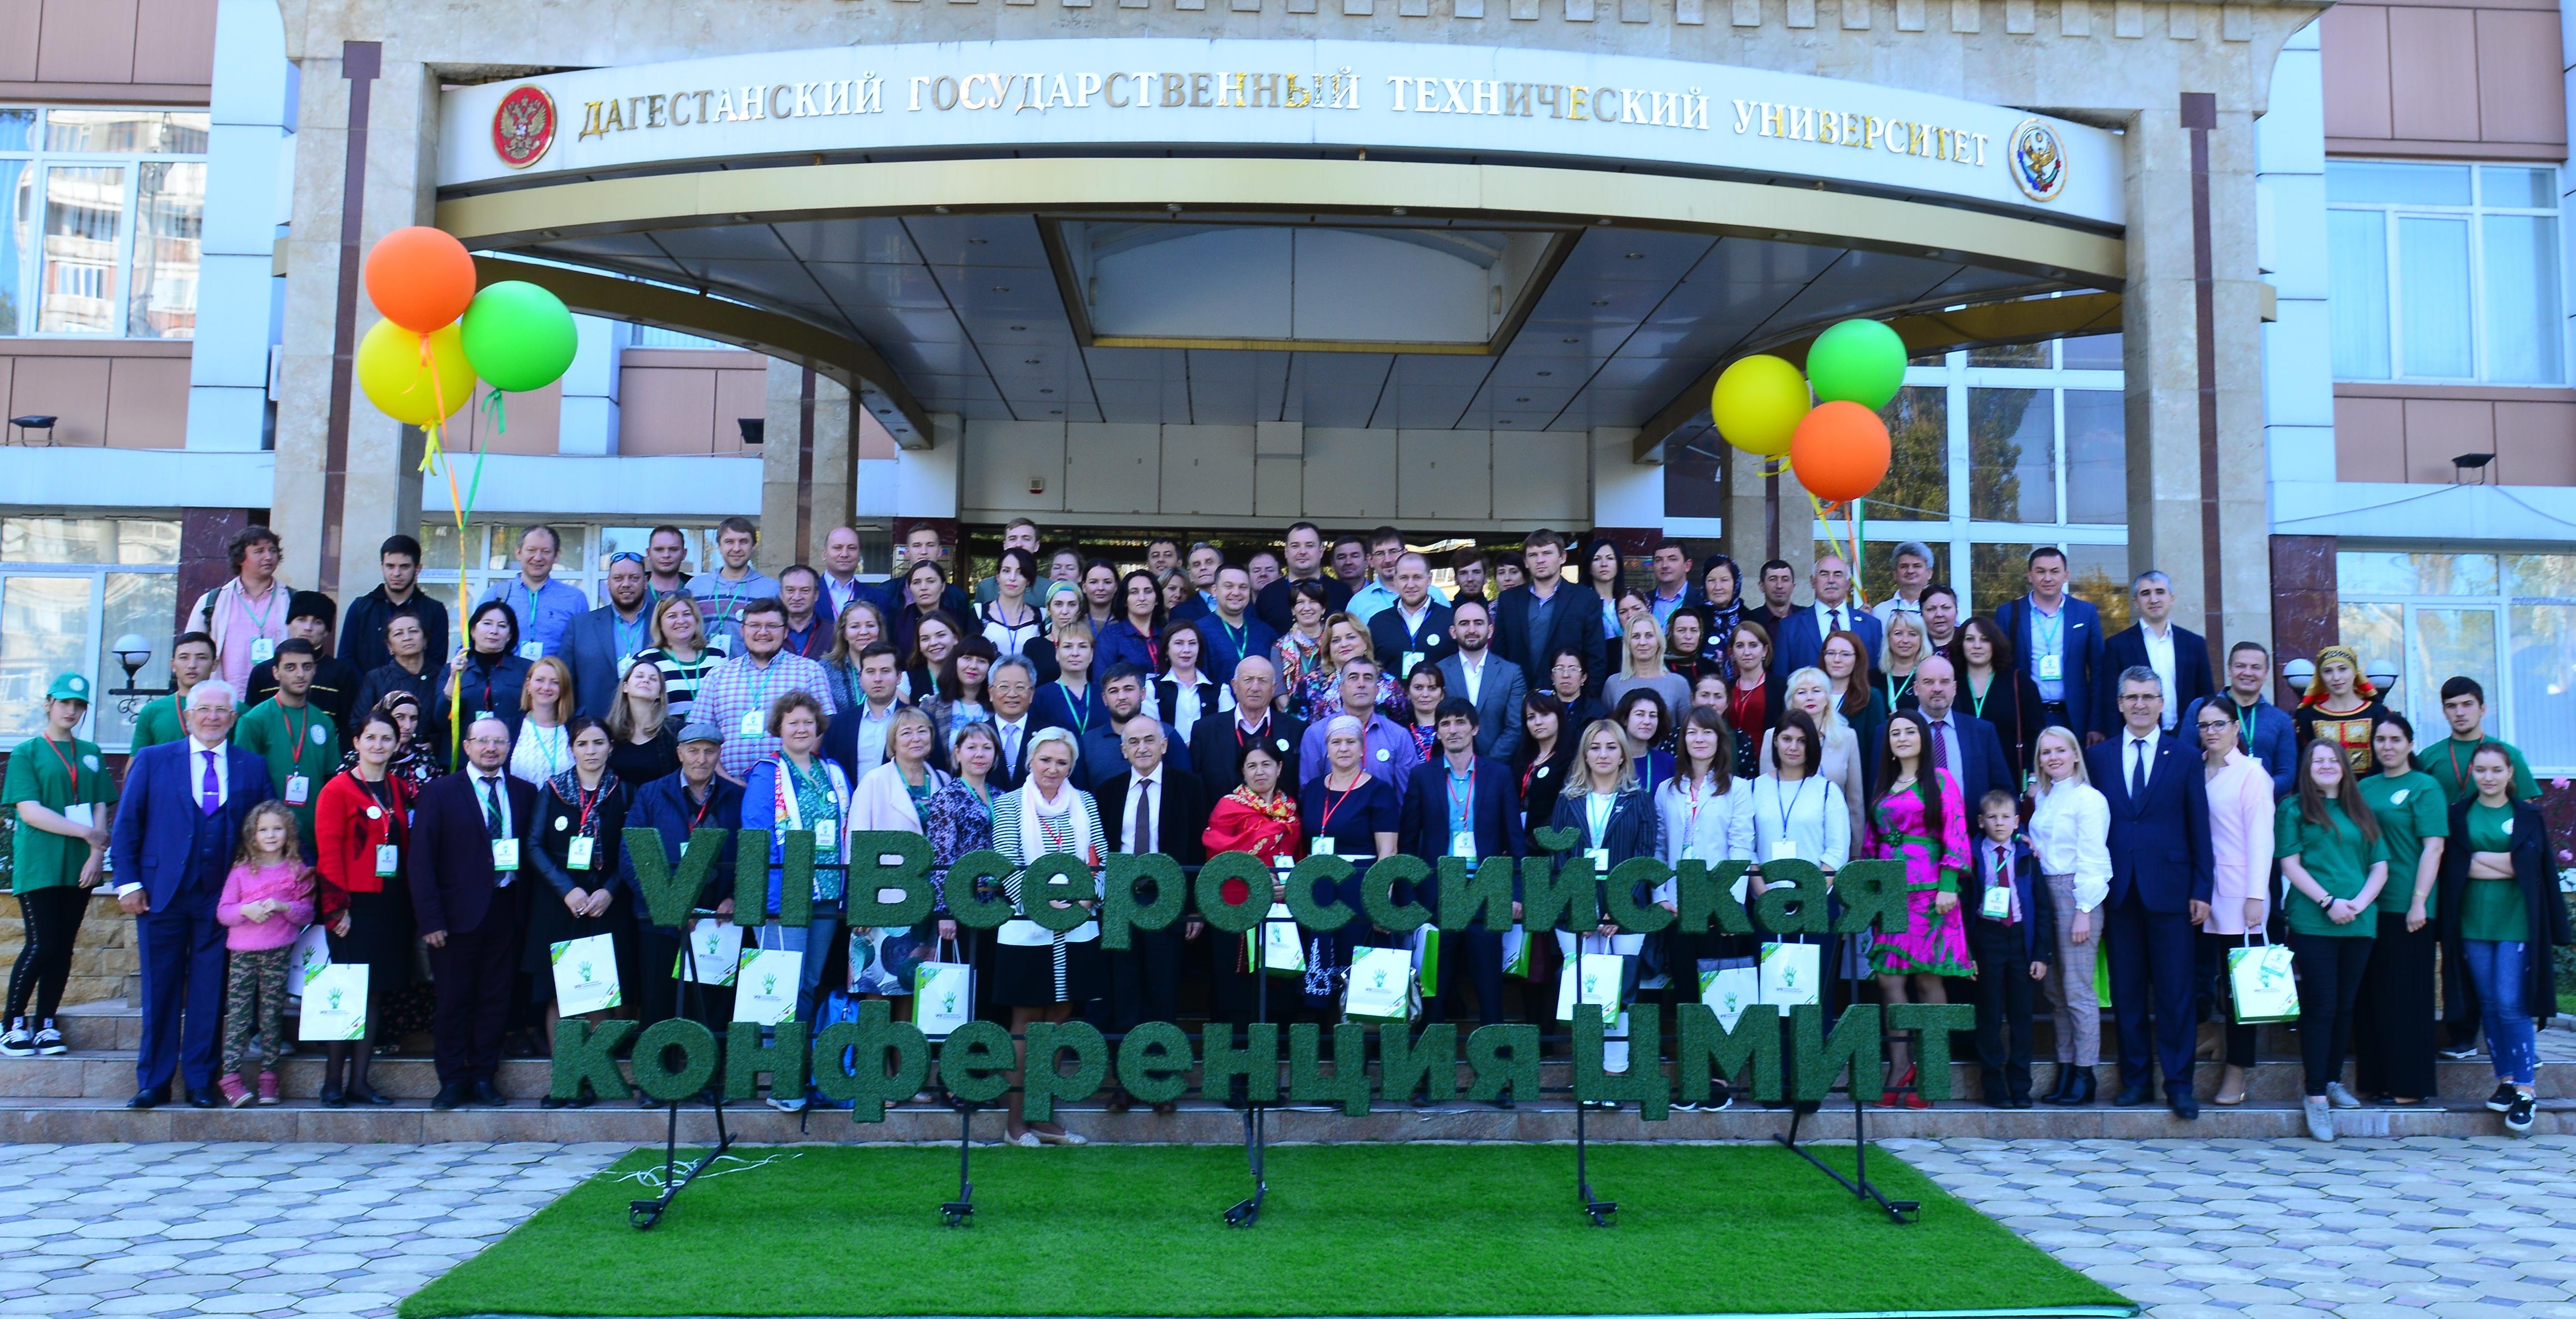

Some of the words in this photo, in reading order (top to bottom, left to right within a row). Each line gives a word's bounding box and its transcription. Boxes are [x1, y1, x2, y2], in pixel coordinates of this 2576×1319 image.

[578, 70, 885, 143] ДАГЕСТАНСКИЙ
[906, 65, 1361, 115] ГОСУДАРСТВЕННЫЙ
[1386, 76, 1710, 130] ТЕХНИЧЕСКИЙ
[1732, 99, 1989, 167] УНИВЕРСИТЕТ
[622, 827, 815, 928] VII
[846, 826, 1908, 951] Всероссийская
[550, 999, 1540, 1124] конференция
[1572, 1003, 1976, 1121] ЦМИТ
